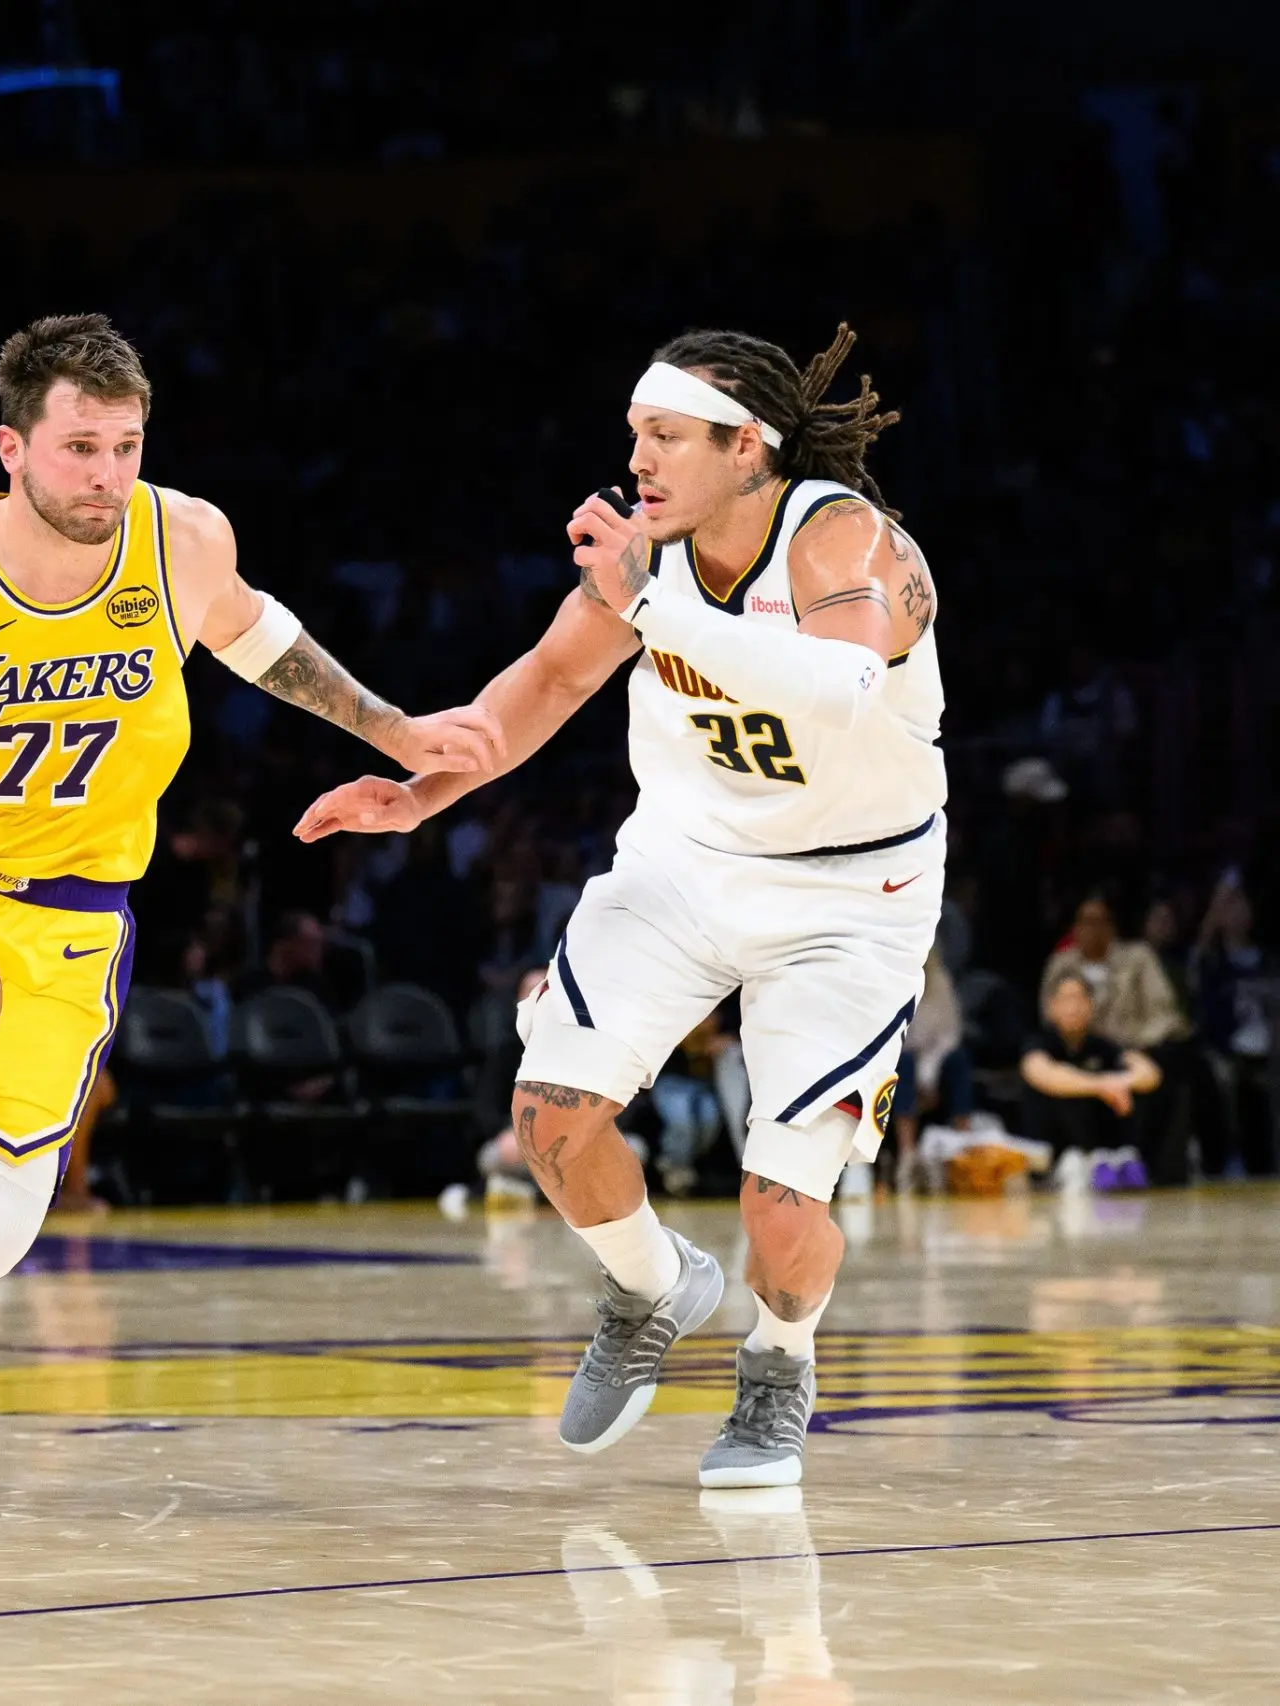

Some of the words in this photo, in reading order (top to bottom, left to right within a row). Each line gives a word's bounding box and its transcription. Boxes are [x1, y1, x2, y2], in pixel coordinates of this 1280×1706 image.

[111, 597, 156, 615] bibigo
[751, 596, 791, 615] ibotta
[688, 711, 807, 787] 32
